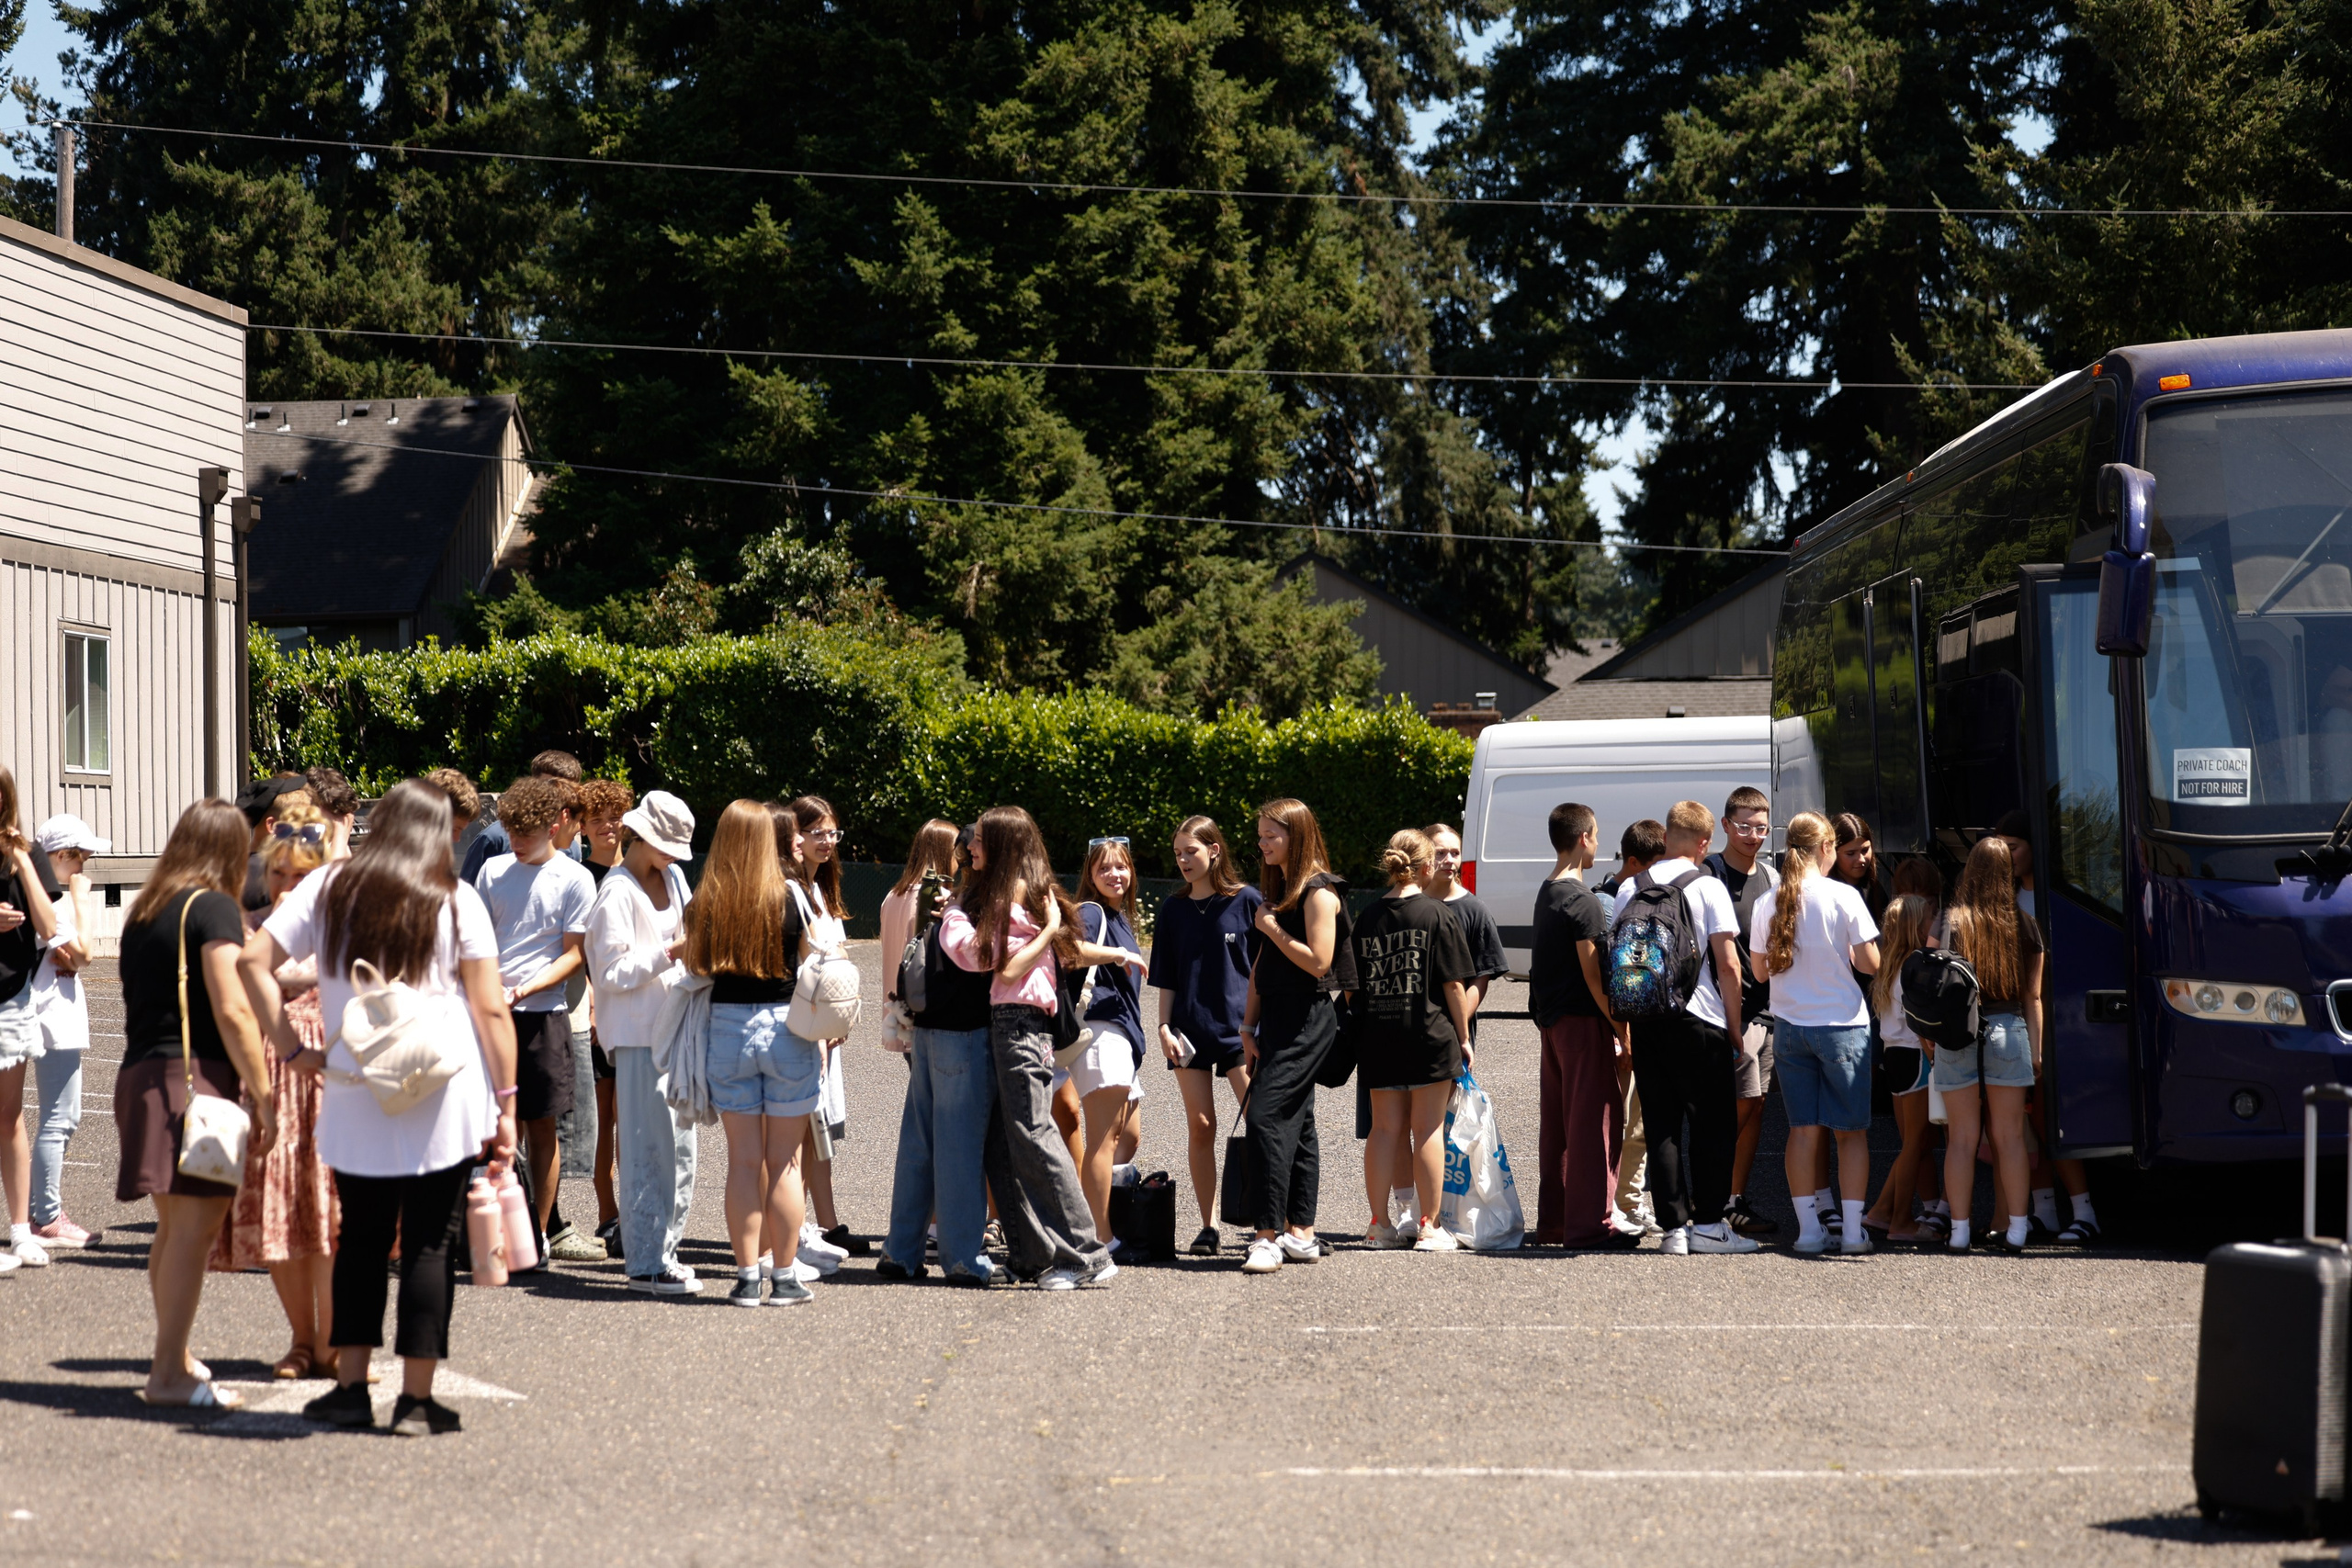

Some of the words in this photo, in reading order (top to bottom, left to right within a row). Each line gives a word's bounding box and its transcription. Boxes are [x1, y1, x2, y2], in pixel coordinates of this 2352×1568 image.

[2177, 760, 2213, 772] PRIVATE
[2216, 760, 2247, 771] COACH
[2181, 783, 2199, 795] NOT
[2201, 782, 2219, 794] FOR
[2221, 782, 2244, 794] HIRE
[1361, 929, 1428, 958] FAITH
[1366, 950, 1421, 979] OVER
[1444, 1150, 1467, 1168] or
